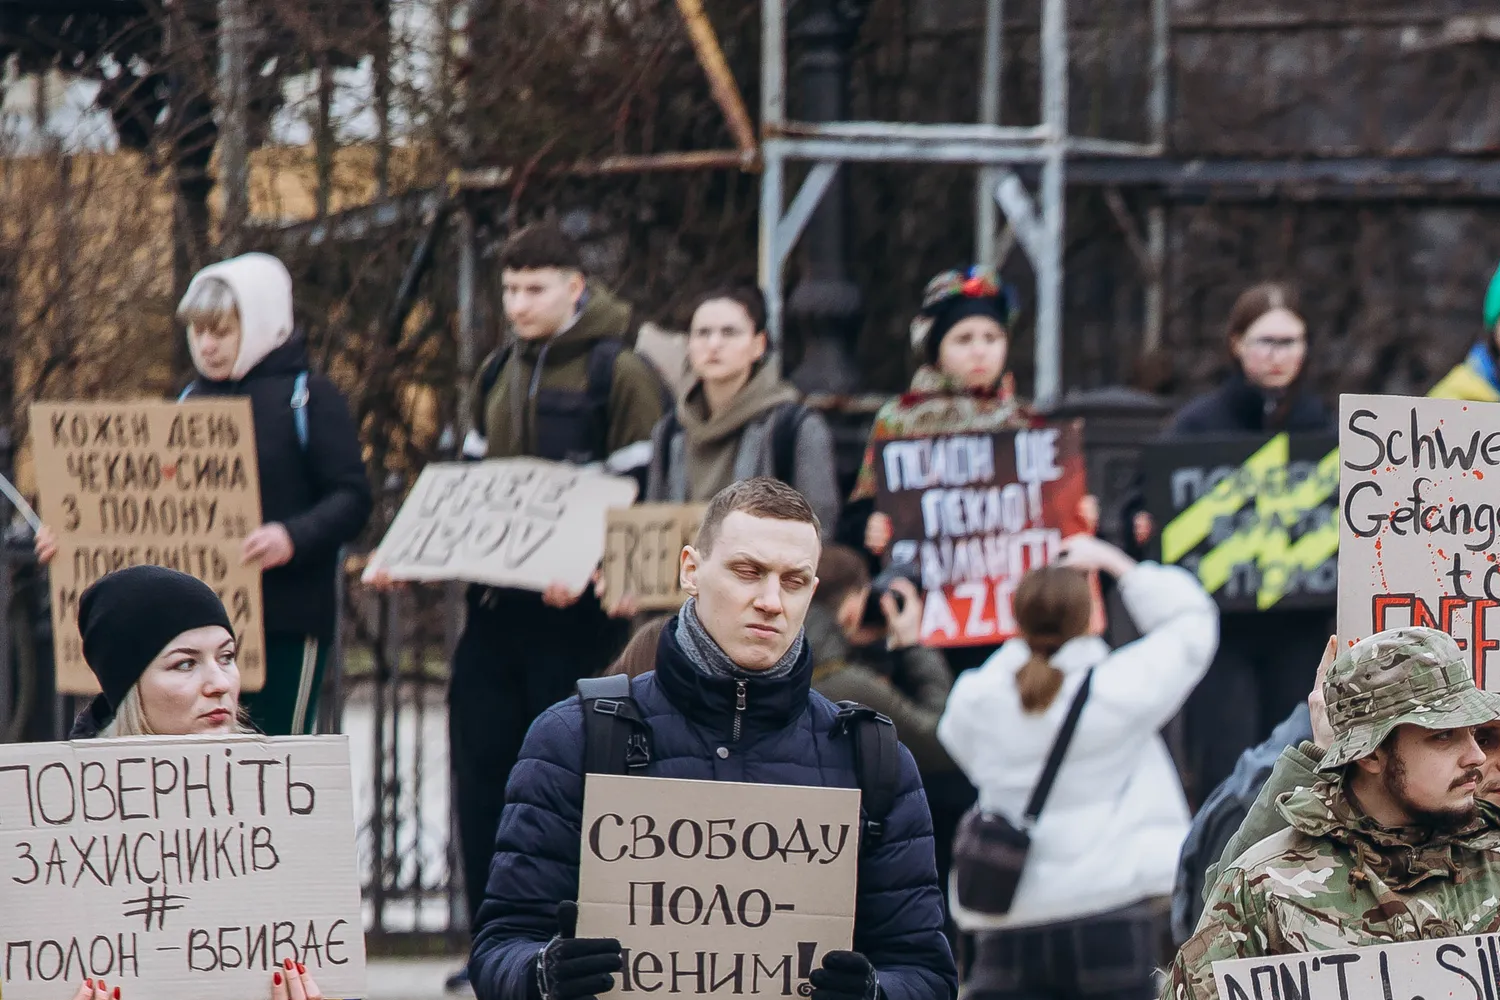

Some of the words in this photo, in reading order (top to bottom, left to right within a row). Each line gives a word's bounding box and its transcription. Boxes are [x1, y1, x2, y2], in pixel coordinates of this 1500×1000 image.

[51, 411, 150, 449] КОЖЕН
[166, 412, 241, 449] ДЕНЬ
[66, 451, 162, 492] ЧЕКАЮ
[175, 452, 249, 491] СИНА
[589, 813, 850, 865] СВОБОДУ
[6, 932, 139, 983] ПОЛОН
